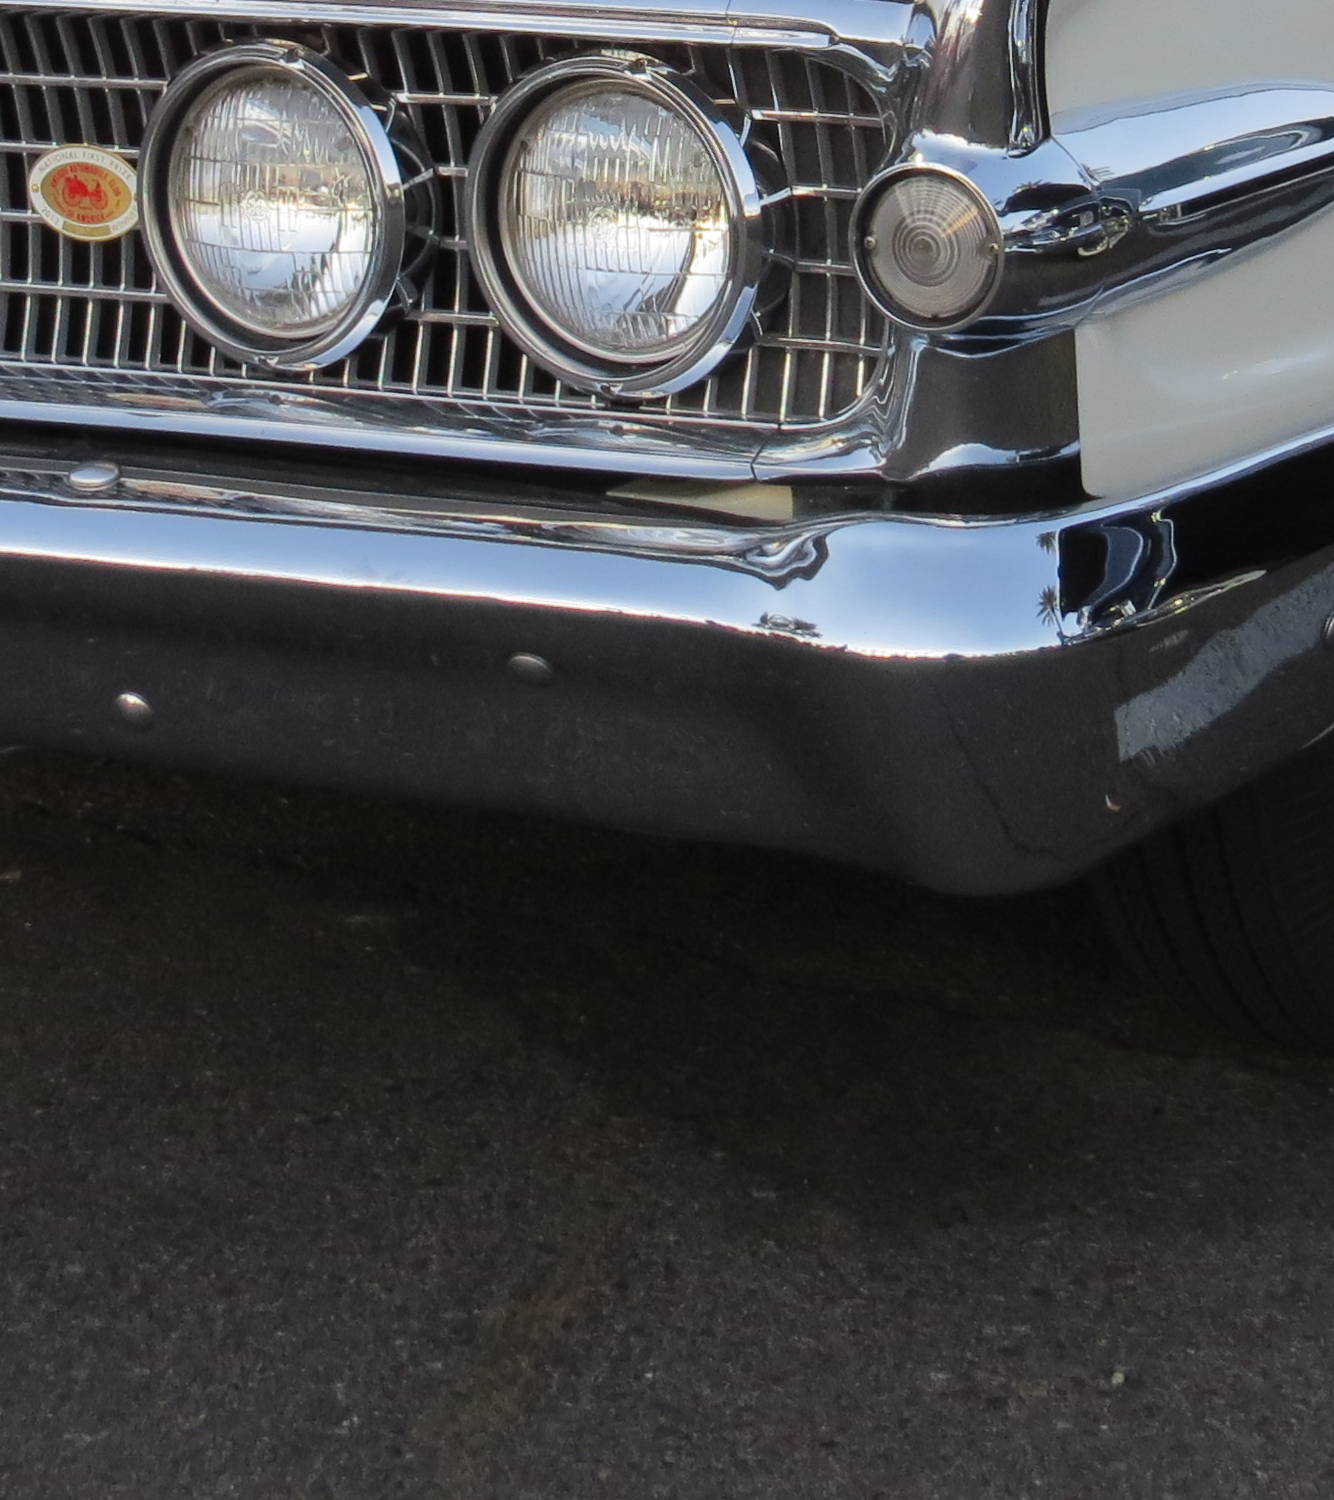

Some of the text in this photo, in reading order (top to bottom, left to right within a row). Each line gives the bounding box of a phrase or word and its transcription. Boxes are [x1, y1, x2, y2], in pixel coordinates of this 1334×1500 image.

[38, 151, 133, 180] NATIONAL FIRST PRIZE
